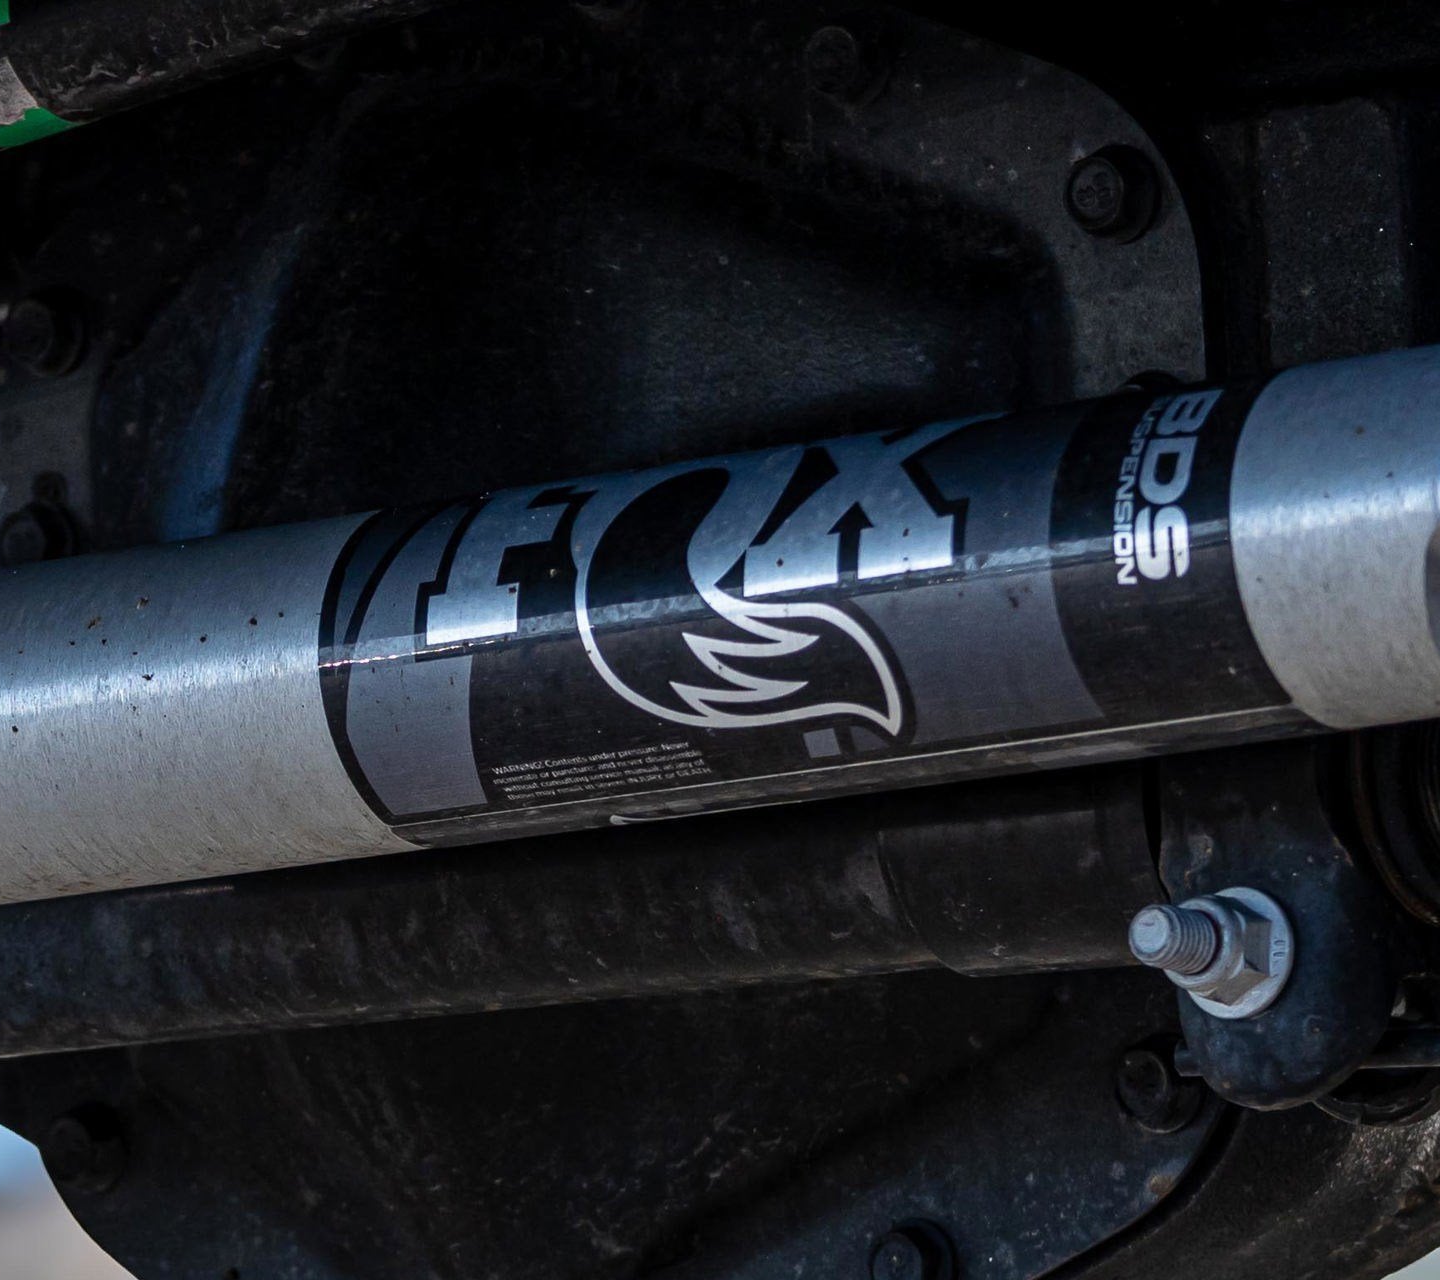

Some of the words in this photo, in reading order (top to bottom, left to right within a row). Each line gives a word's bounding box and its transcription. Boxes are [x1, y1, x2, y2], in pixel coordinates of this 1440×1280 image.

[425, 412, 1010, 737] FOX
[1113, 396, 1172, 585] SUSPENSION
[1134, 388, 1224, 580] BDS
